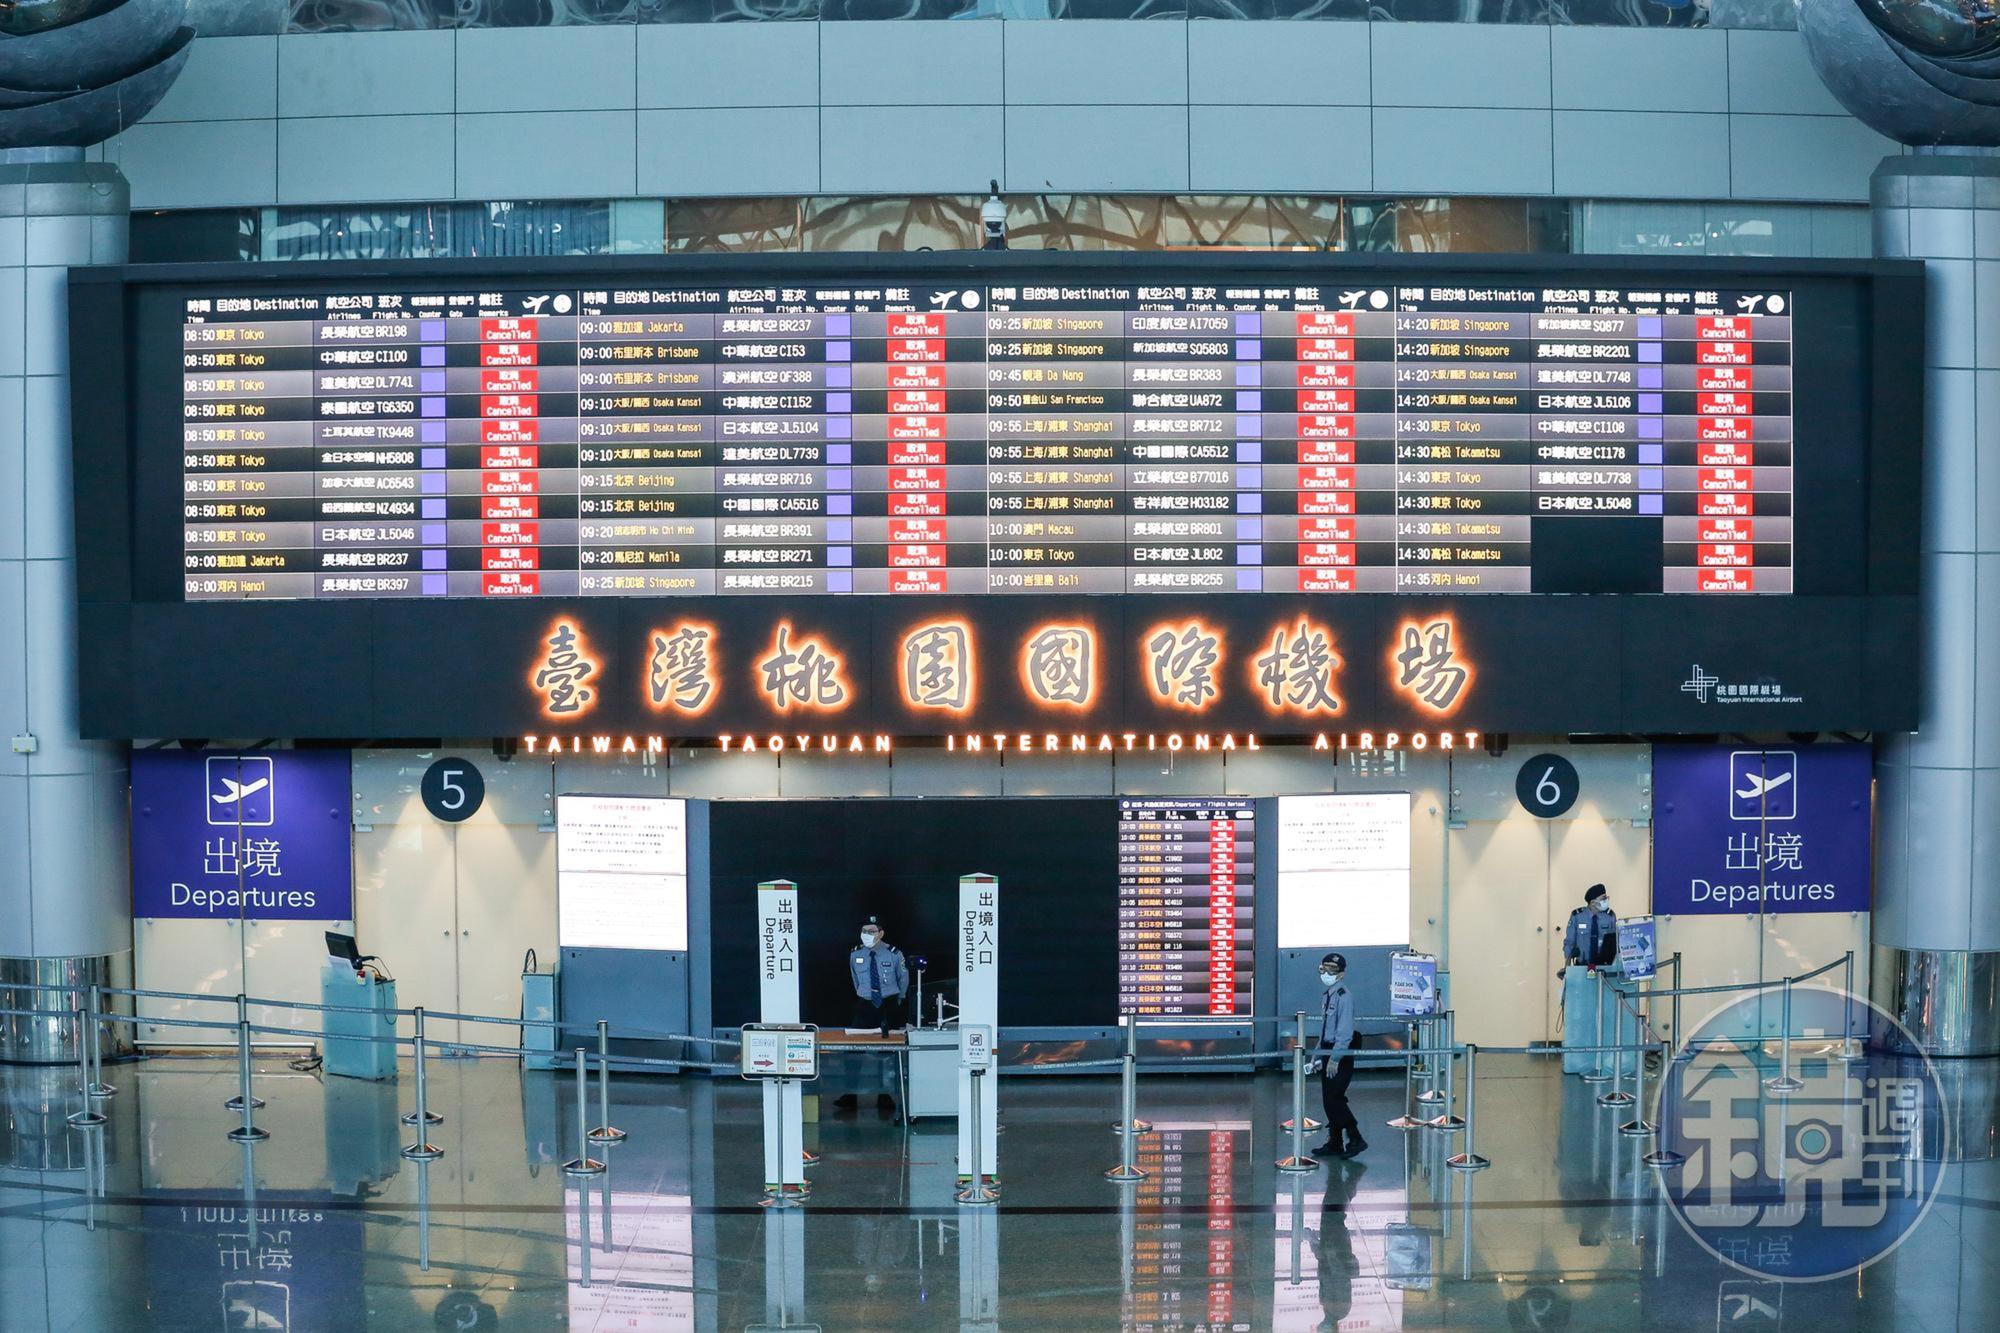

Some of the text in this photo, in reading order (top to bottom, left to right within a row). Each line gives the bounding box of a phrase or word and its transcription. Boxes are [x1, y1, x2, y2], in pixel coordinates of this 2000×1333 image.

[653, 291, 719, 302] Destination
[1062, 288, 1129, 299] Destination
[1469, 290, 1534, 301] Destination
[254, 298, 318, 310] Destination
[779, 320, 811, 331] BR237
[1190, 318, 1228, 329] AI7059
[376, 325, 407, 337] BR198
[579, 347, 612, 359] 09:00
[658, 347, 698, 357] Brisbane
[780, 345, 805, 356] CI53
[989, 344, 1021, 355] 09:25
[1058, 344, 1103, 355] Singapore
[1396, 344, 1429, 355] 14:20
[1465, 345, 1509, 356] Singapore
[1593, 345, 1630, 357] BR2201
[184, 355, 215, 366] 08:50
[240, 354, 264, 365] Tokyo
[376, 350, 407, 362] CI100
[486, 354, 531, 365] Cancelled
[658, 373, 698, 383] Brisbane
[989, 370, 1021, 381] 09:45
[1190, 369, 1222, 380] BR383
[376, 376, 413, 388] DL7741
[581, 399, 612, 410] 09:10
[780, 396, 812, 408] CI152
[989, 395, 1021, 406] 09:50
[1067, 395, 1103, 403] Francisco
[1190, 394, 1222, 406] UA872
[1396, 395, 1429, 406] 14:20
[1594, 396, 1631, 408] JL5106
[185, 401, 414, 417] 08:50 Tokyo TG6350
[780, 422, 818, 433] JL5104
[1190, 420, 1222, 431] BR712
[1594, 422, 1625, 433] CI108
[377, 427, 413, 438] TK9448
[581, 450, 613, 461] 09:10
[780, 448, 818, 459] DL7739
[990, 446, 1021, 458] 09:55
[1190, 446, 1228, 457] CA5512
[1303, 452, 1349, 462] Cancelled
[1399, 446, 1430, 458] 14:30
[1594, 447, 1625, 459] CI178
[185, 455, 216, 467] 08:50
[240, 455, 265, 466] Tokyo
[377, 477, 414, 489] AC6543
[639, 475, 674, 486] Beijing
[780, 473, 812, 484] BR716
[580, 500, 613, 512] 09:15
[639, 500, 674, 512] Beijing
[781, 499, 819, 510] CA5516
[893, 504, 940, 514] Cancelled
[990, 497, 1022, 509] 09:55
[1397, 497, 1430, 508] 14:30
[1456, 497, 1481, 509] Tokyo
[1594, 497, 1631, 509] JL5048
[185, 503, 414, 517] 08:50 Tokyo NZ4934
[377, 528, 414, 540] JL5046
[781, 525, 812, 536] BR391
[990, 523, 1222, 535] 10:00 Macau BR801
[186, 553, 408, 567] 09:00 Jakarta BR237
[580, 552, 613, 563] 09:20
[781, 550, 812, 562] BR271
[991, 549, 1022, 560] 10:00
[1049, 549, 1074, 561] Tokyo
[1191, 548, 1222, 560] JL802
[1397, 548, 1430, 559] 14:30
[1702, 554, 1747, 565] Cancelled
[377, 579, 408, 590] BR397
[650, 575, 813, 588] Singapore BR215
[1191, 574, 1223, 585] BR255
[1397, 573, 1430, 585] 14:35
[524, 732, 1480, 752] TAIWAN TAOYUAN INTERNATIONAL AIRPORT
[441, 770, 465, 809] 5
[1535, 766, 1561, 806] 6
[204, 837, 282, 877] 出境
[1725, 832, 1803, 871] 出境
[171, 883, 316, 912] Departures
[1691, 879, 1835, 907] Departures
[778, 898, 793, 972] 出境入口
[978, 892, 993, 965] 出境入口
[962, 910, 977, 972] Departure
[763, 917, 776, 980] Departure
